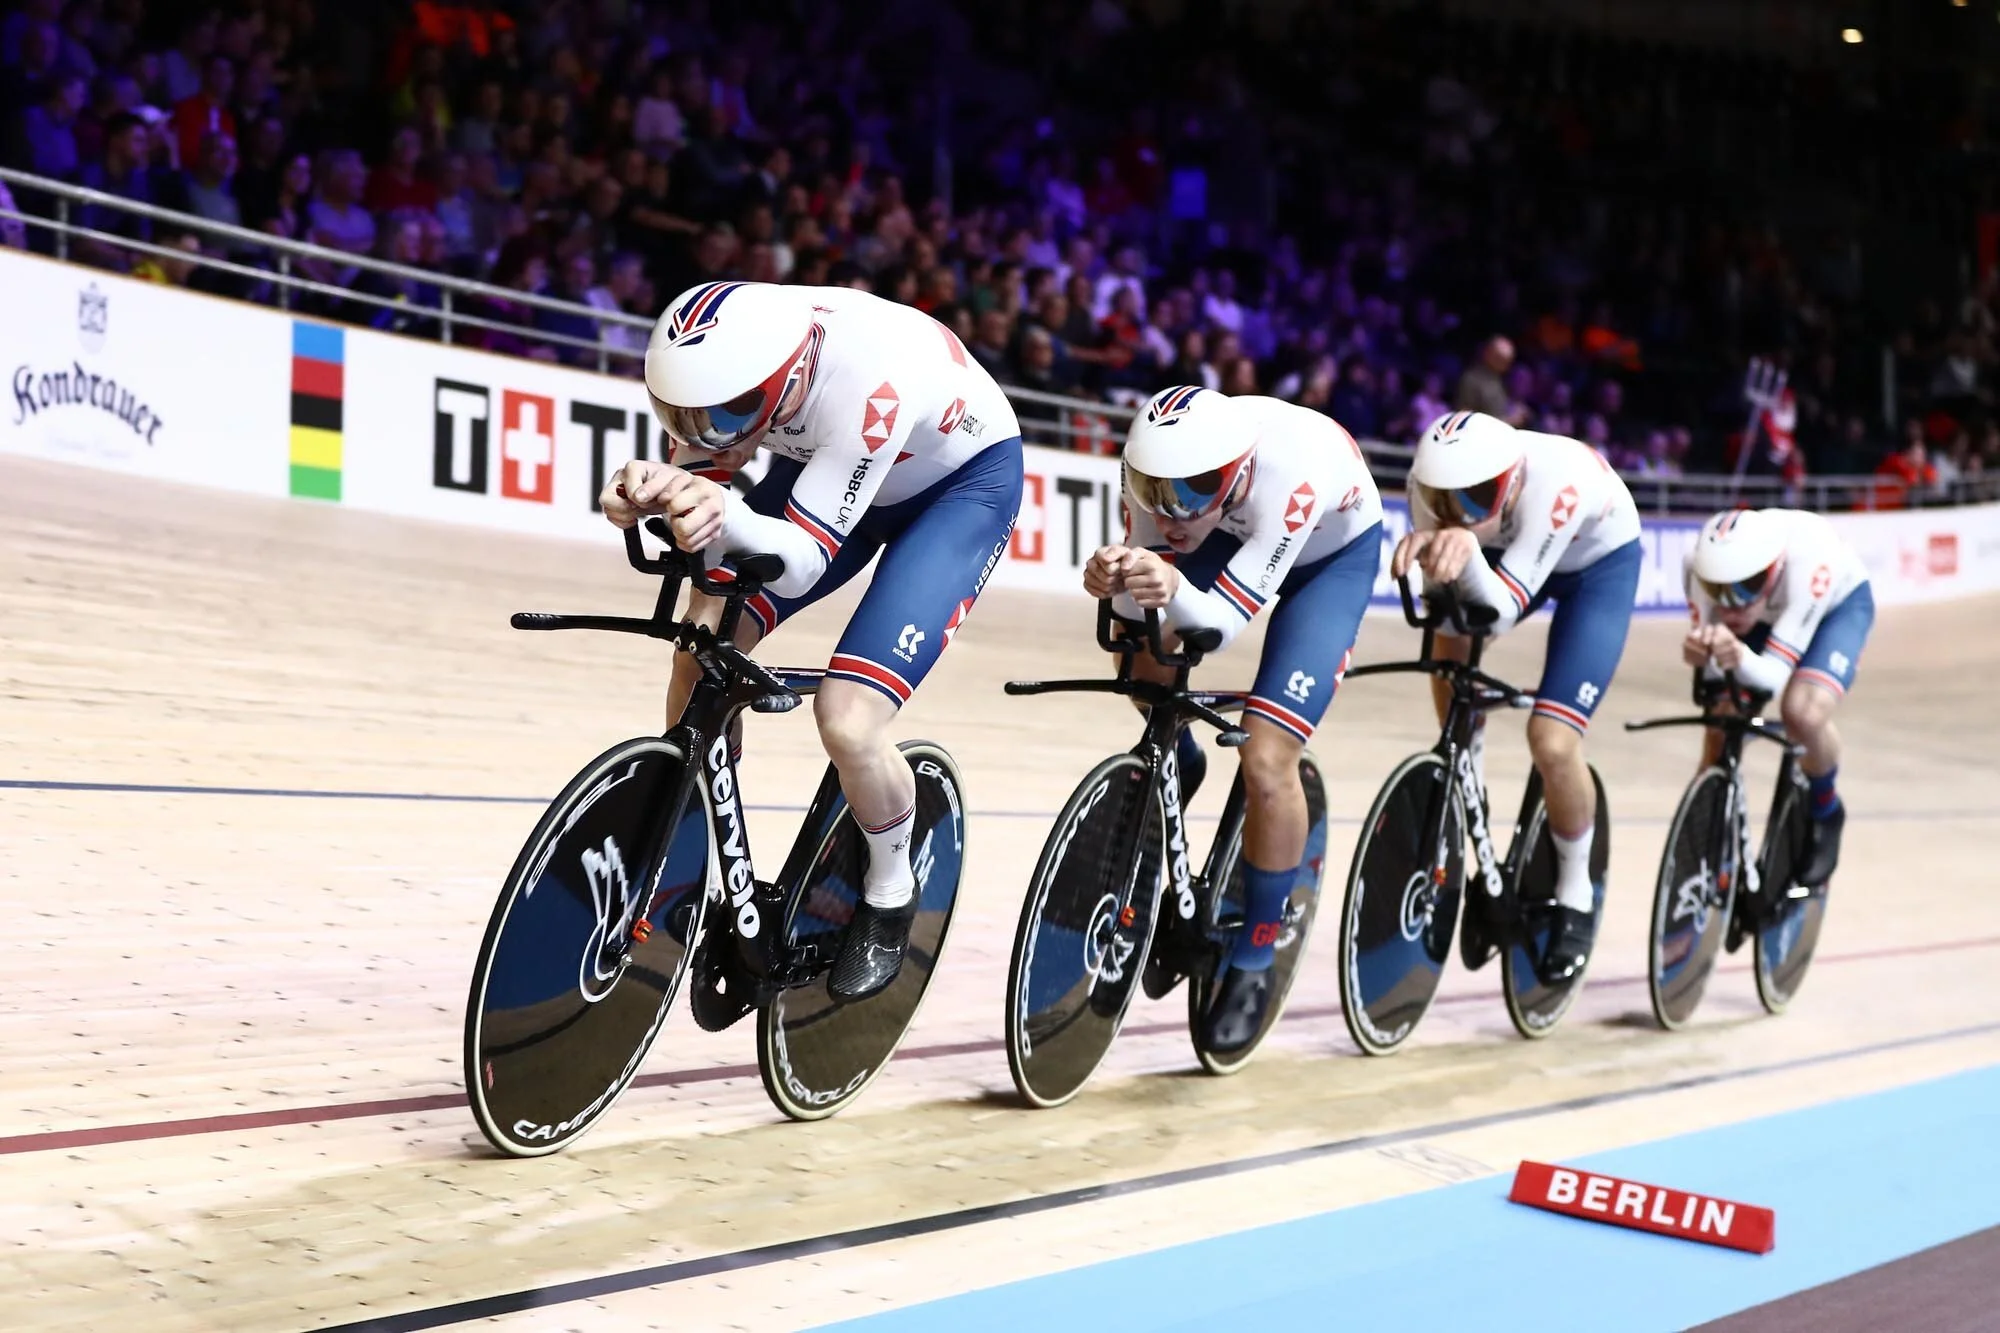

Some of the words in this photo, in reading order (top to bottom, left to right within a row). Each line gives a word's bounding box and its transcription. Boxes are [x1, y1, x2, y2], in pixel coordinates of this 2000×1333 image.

[13, 360, 162, 446] Kondrauer
[844, 458, 873, 505] HSBC
[835, 506, 853, 529] UK
[974, 542, 1003, 594] HSBC
[1002, 513, 1017, 541] UK
[1266, 536, 1292, 574] HSBC
[1257, 574, 1271, 592] UK
[1546, 1169, 1735, 1237] BERLIN
